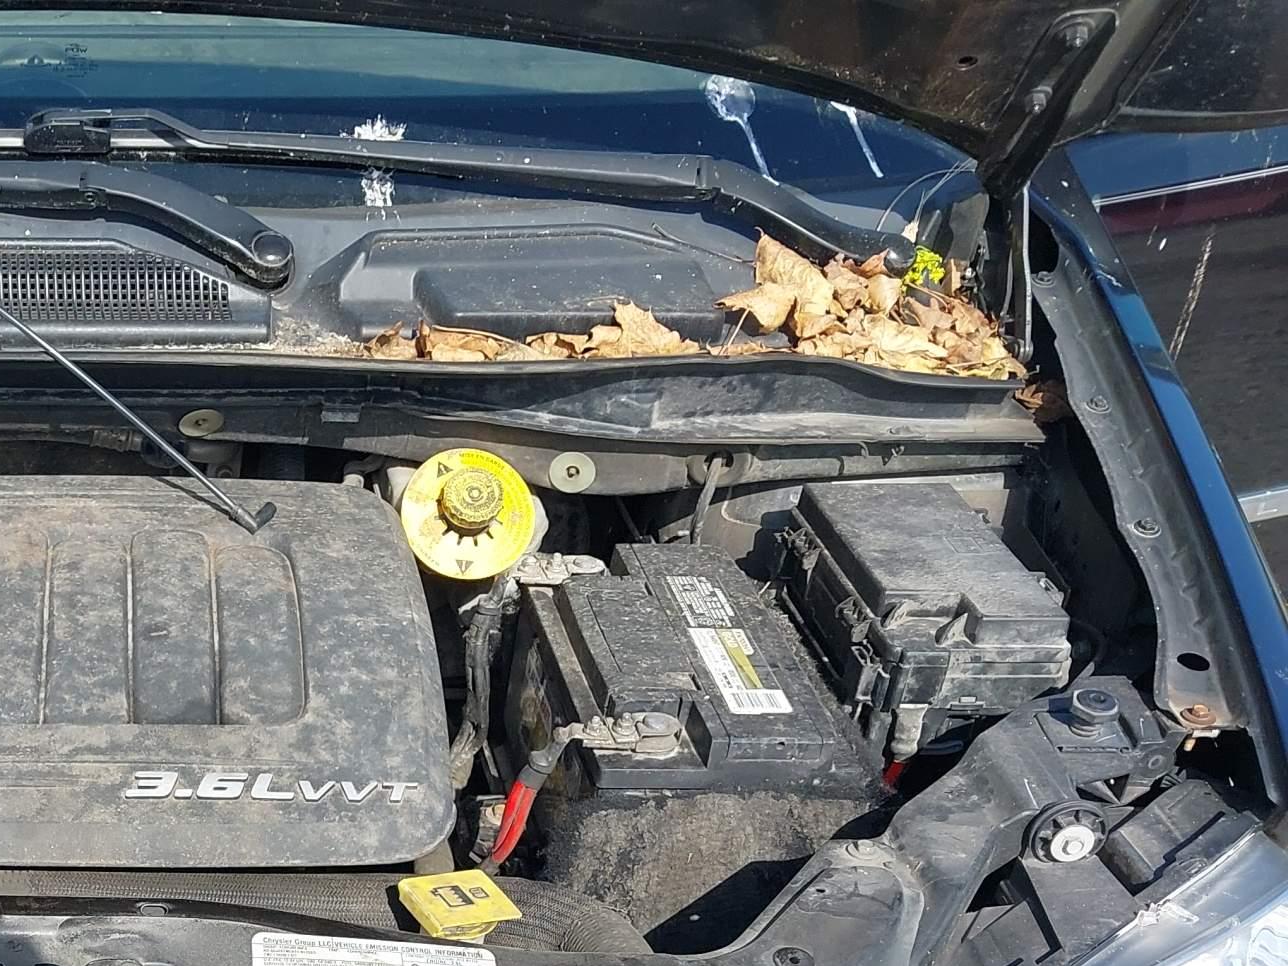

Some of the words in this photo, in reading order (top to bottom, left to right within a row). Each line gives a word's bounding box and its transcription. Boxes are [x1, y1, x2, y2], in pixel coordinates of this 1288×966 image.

[125, 771, 295, 800] 3.6L
[298, 780, 418, 804] VVT
[263, 937, 292, 946] Chrysler
[295, 938, 316, 947] Group
[365, 944, 399, 952] EMISSION
[401, 946, 431, 955] CONTROL
[435, 949, 484, 959] INFORMATION
